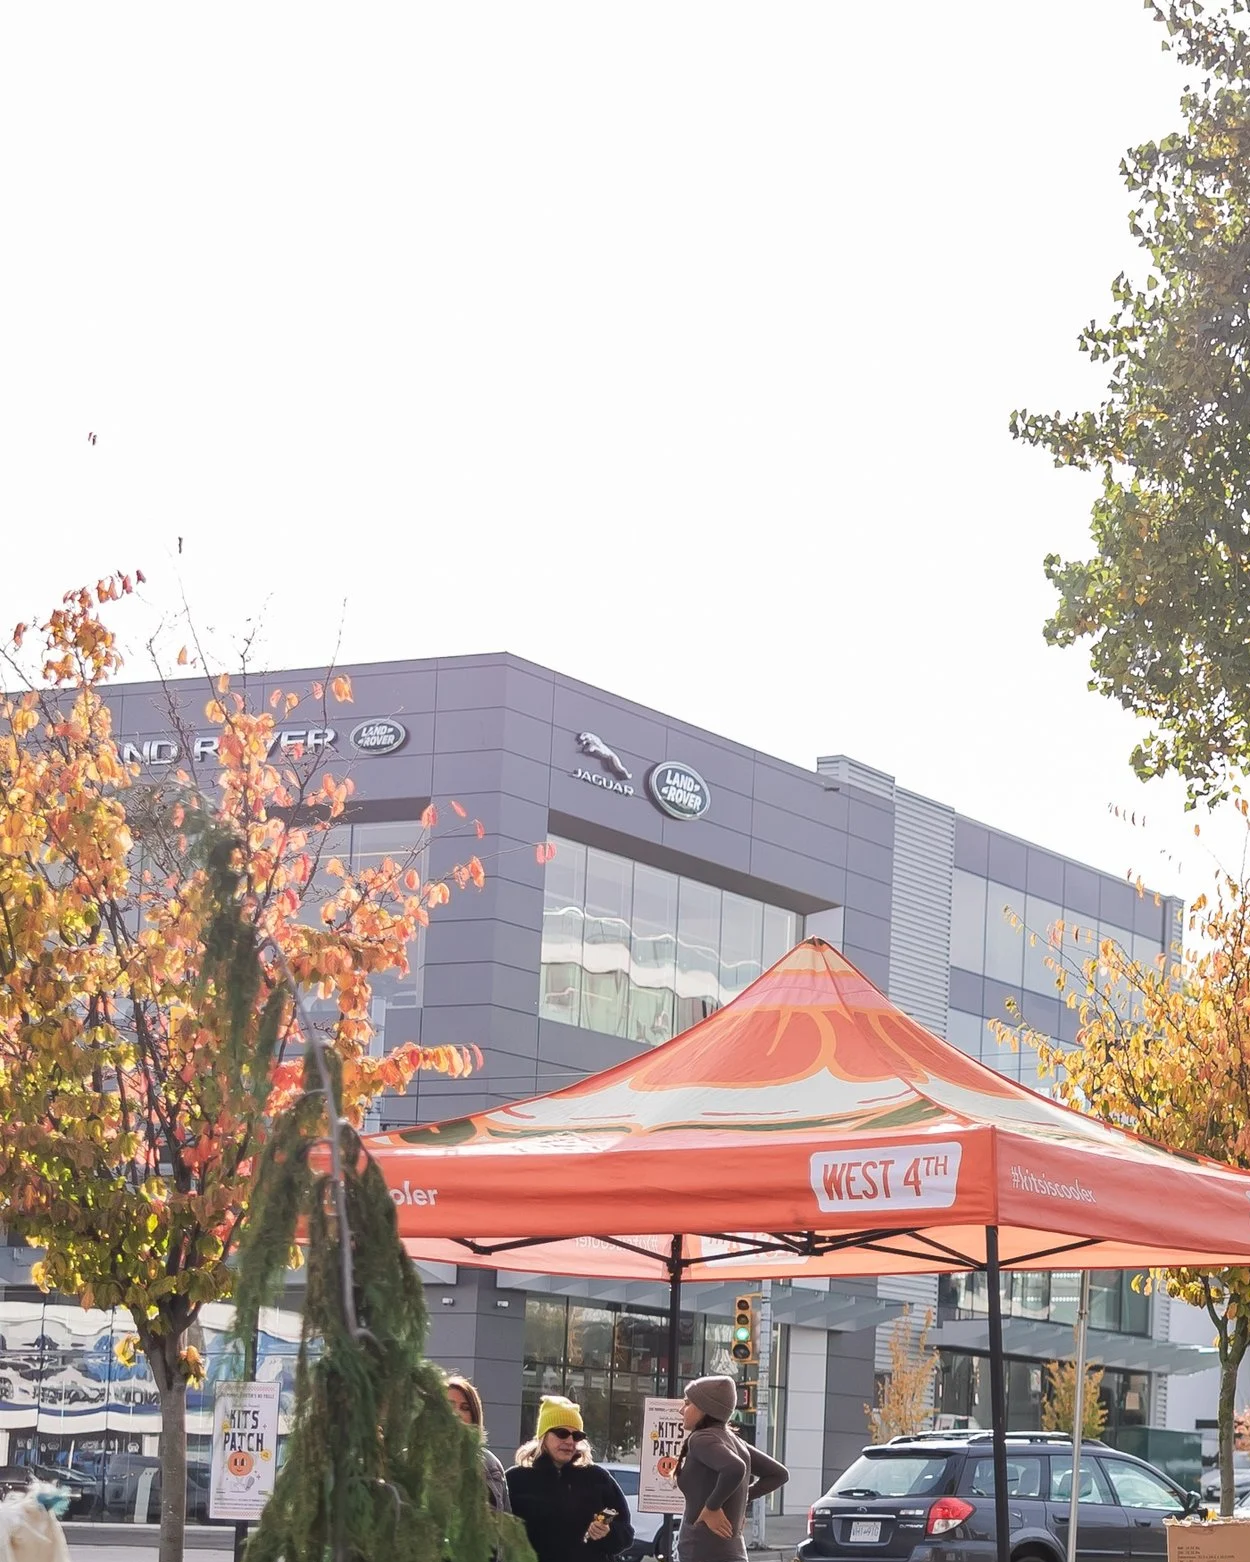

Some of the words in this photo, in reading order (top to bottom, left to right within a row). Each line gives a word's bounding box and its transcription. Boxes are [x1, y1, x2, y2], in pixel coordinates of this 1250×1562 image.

[361, 725, 388, 737] LAND
[362, 734, 396, 747] ROVER
[572, 768, 634, 796] JAGUAR
[665, 769, 696, 792] LAND
[667, 786, 702, 811] ROVER
[822, 1159, 895, 1201] WEST
[903, 1155, 949, 1197] 4TH
[1011, 1165, 1097, 1203] #kitsiscooler
[230, 1409, 260, 1429] KITS
[658, 1421, 685, 1439] KITS
[224, 1432, 264, 1451] PATCH
[652, 1441, 681, 1457] PATC
